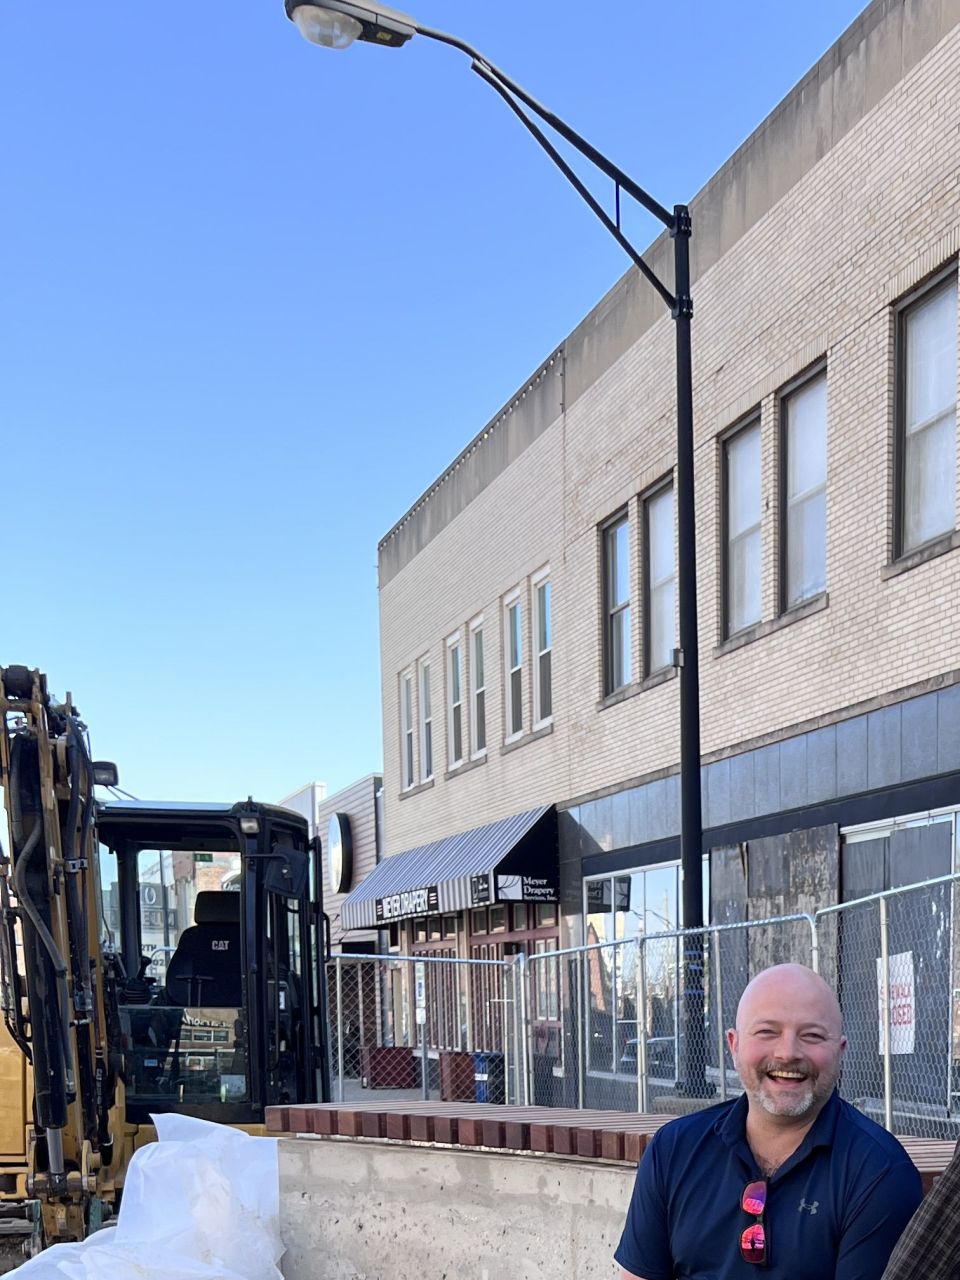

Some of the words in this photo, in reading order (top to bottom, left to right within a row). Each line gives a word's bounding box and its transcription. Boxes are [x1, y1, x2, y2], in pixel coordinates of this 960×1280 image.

[523, 876, 548, 886] Meyer
[523, 885, 555, 895] Drapery
[382, 895, 401, 918] MEYER
[401, 888, 429, 914] DRAPERY
[211, 940, 230, 951] CAT
